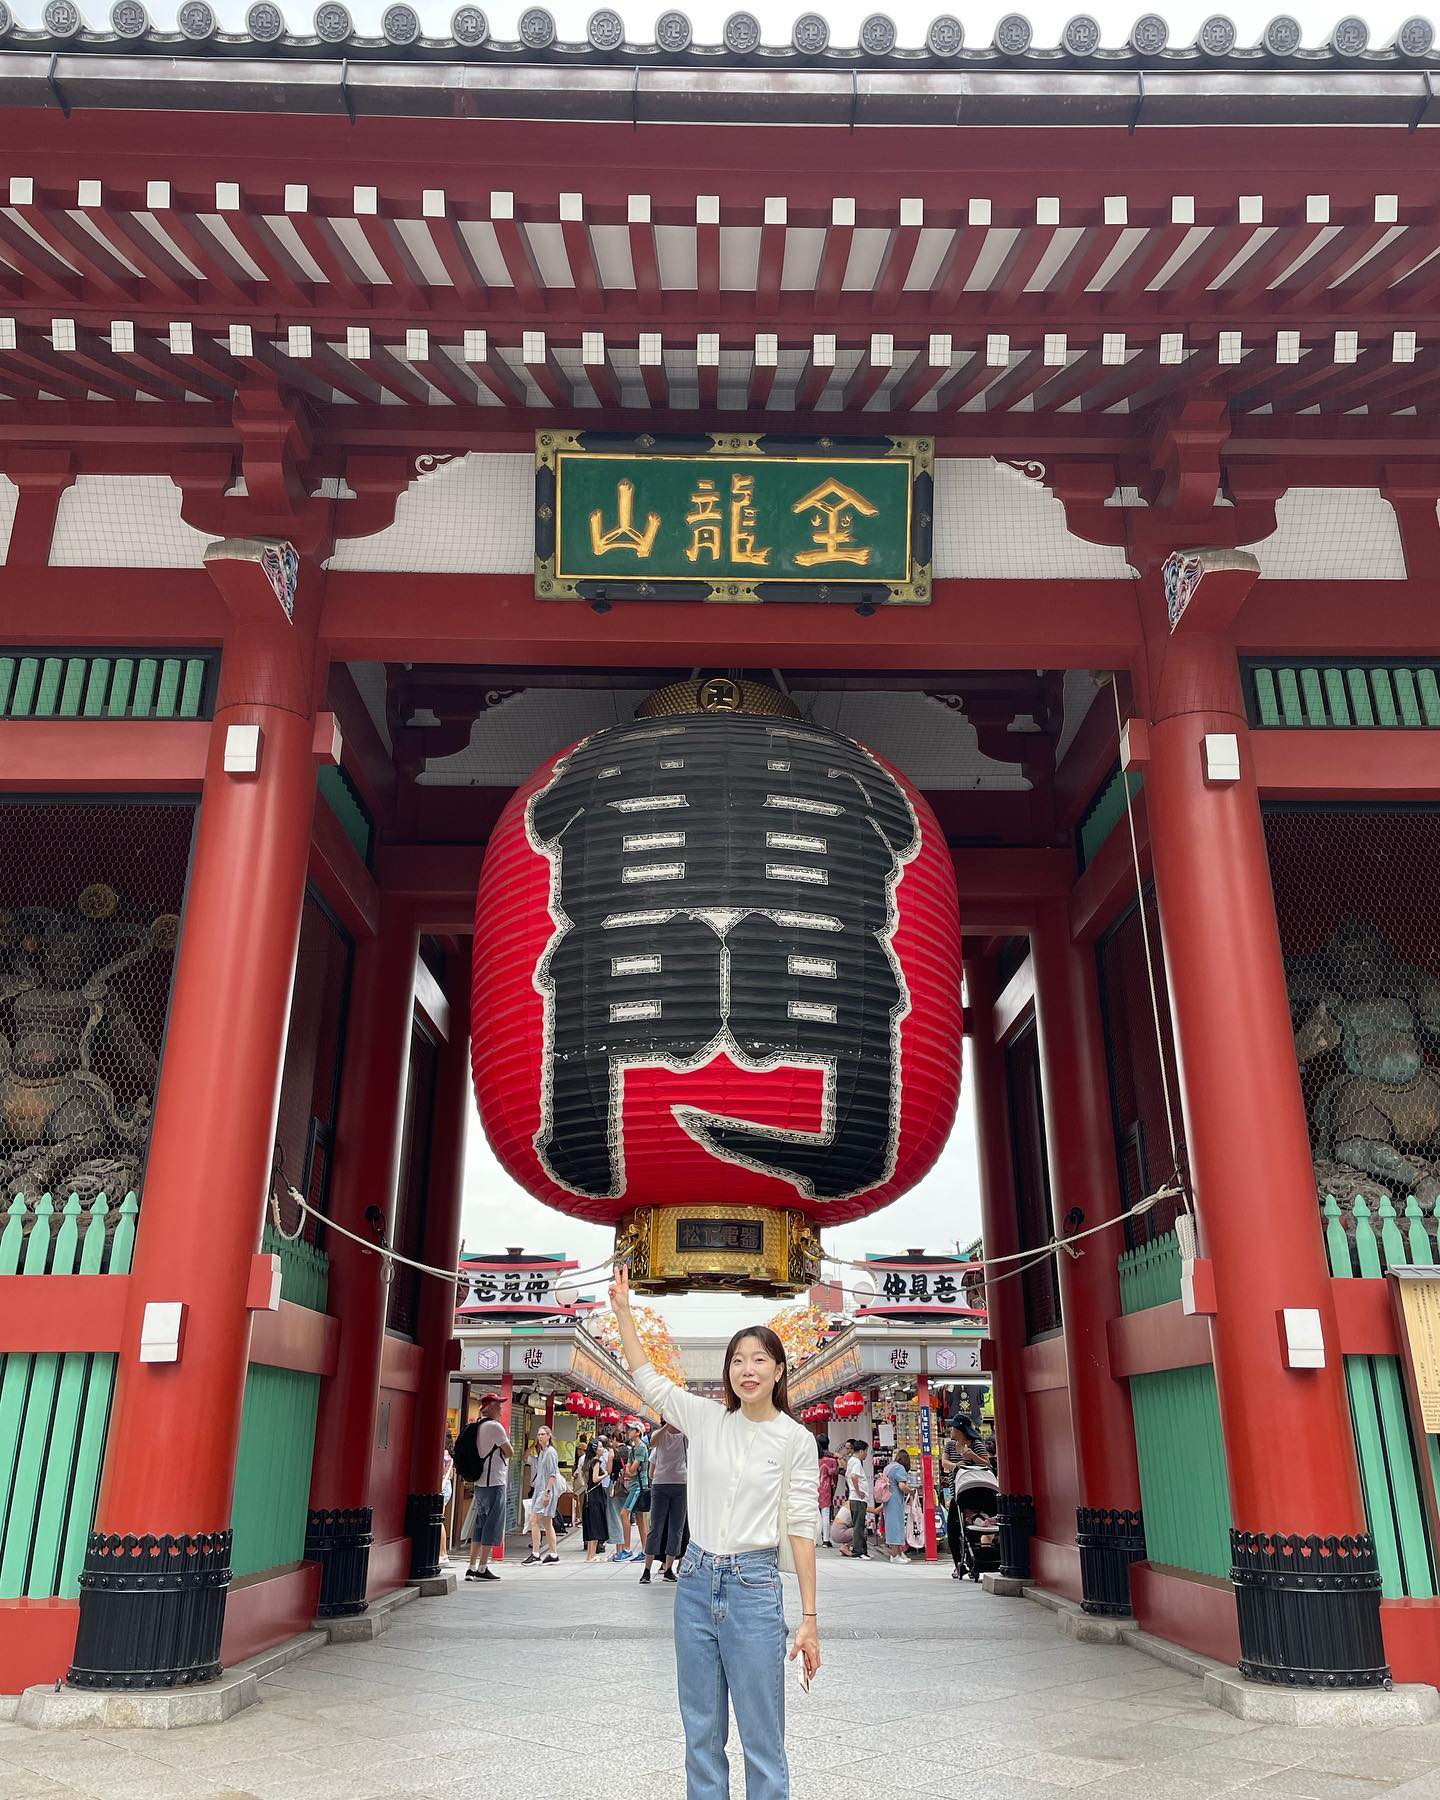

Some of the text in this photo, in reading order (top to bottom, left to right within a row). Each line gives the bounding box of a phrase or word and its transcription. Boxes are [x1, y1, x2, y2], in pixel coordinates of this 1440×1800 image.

[524, 714, 923, 1202] 雷門
[682, 1224, 758, 1249] 松下電器
